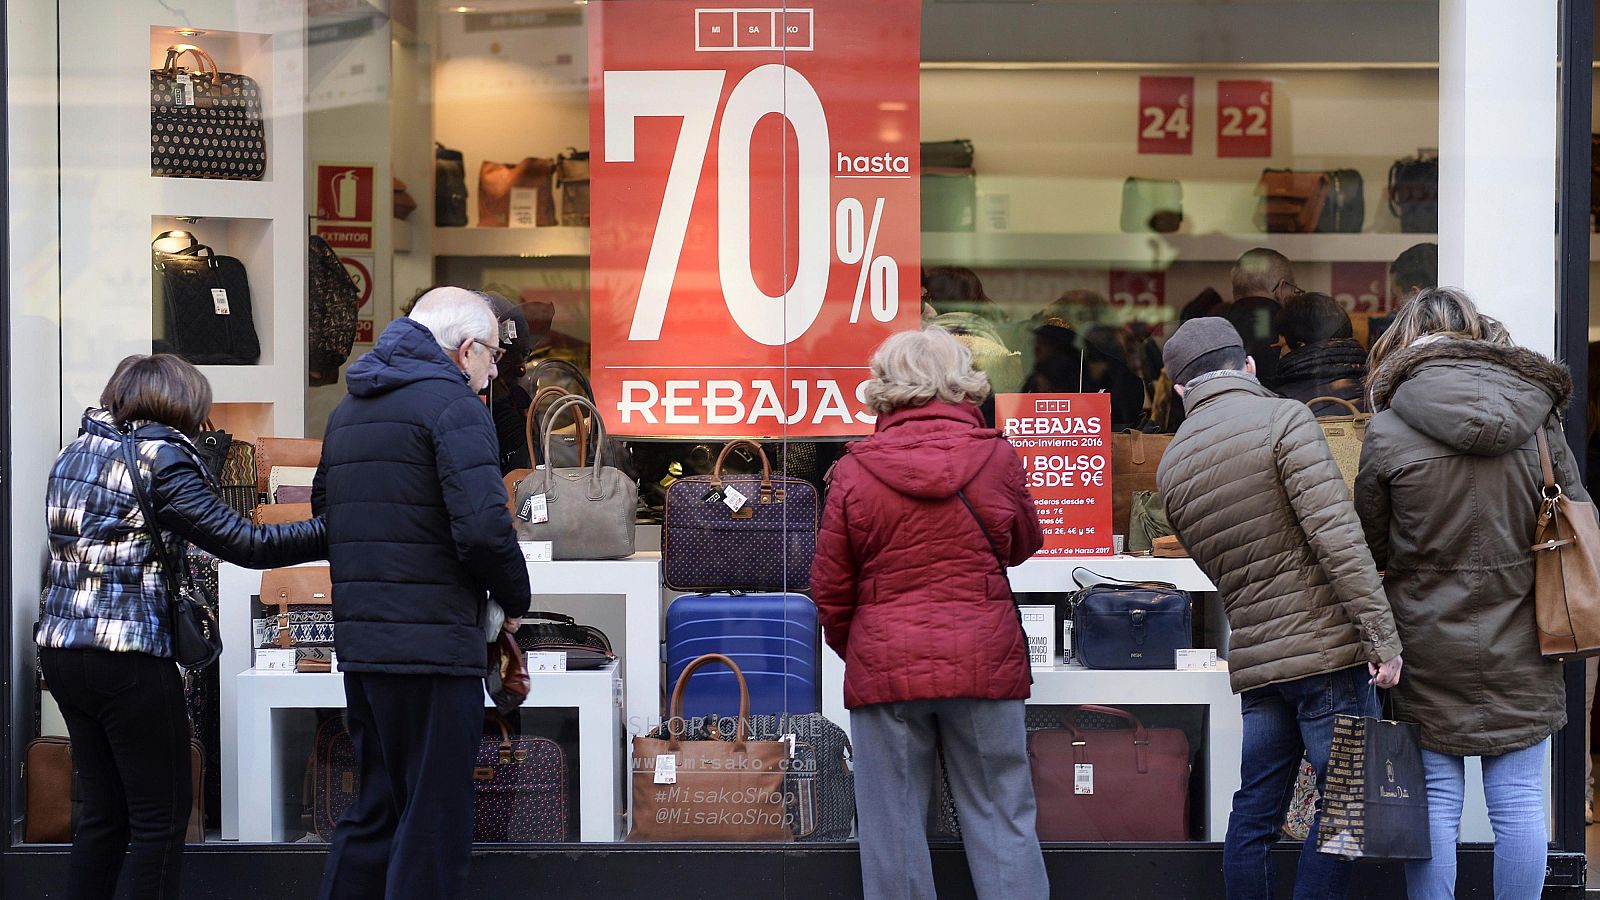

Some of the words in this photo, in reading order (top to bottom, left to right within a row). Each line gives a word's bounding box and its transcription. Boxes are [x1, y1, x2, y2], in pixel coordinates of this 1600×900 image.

[1142, 107, 1190, 139] 24
[1221, 107, 1267, 136] 22
[837, 152, 909, 173] hasta
[603, 63, 831, 346] 70
[320, 232, 369, 242] EXTINTOR
[835, 197, 899, 323] %
[1004, 417, 1101, 435] REBAJAS
[1008, 439, 1078, 447] toño-Invierno
[1081, 438, 1102, 447] 2016
[1034, 455, 1105, 470] BOLSO
[1025, 471, 1074, 486] SDE
[1080, 471, 1104, 486] 9€
[1028, 635, 1047, 646] ÓXIMO
[1030, 646, 1047, 655] MINGO
[1031, 655, 1046, 664] ERTO
[718, 717, 822, 737] ONLINE
[632, 755, 816, 770] www.misako.com
[654, 787, 796, 805] #MisakoShop
[656, 807, 794, 828] @MisakoShop
